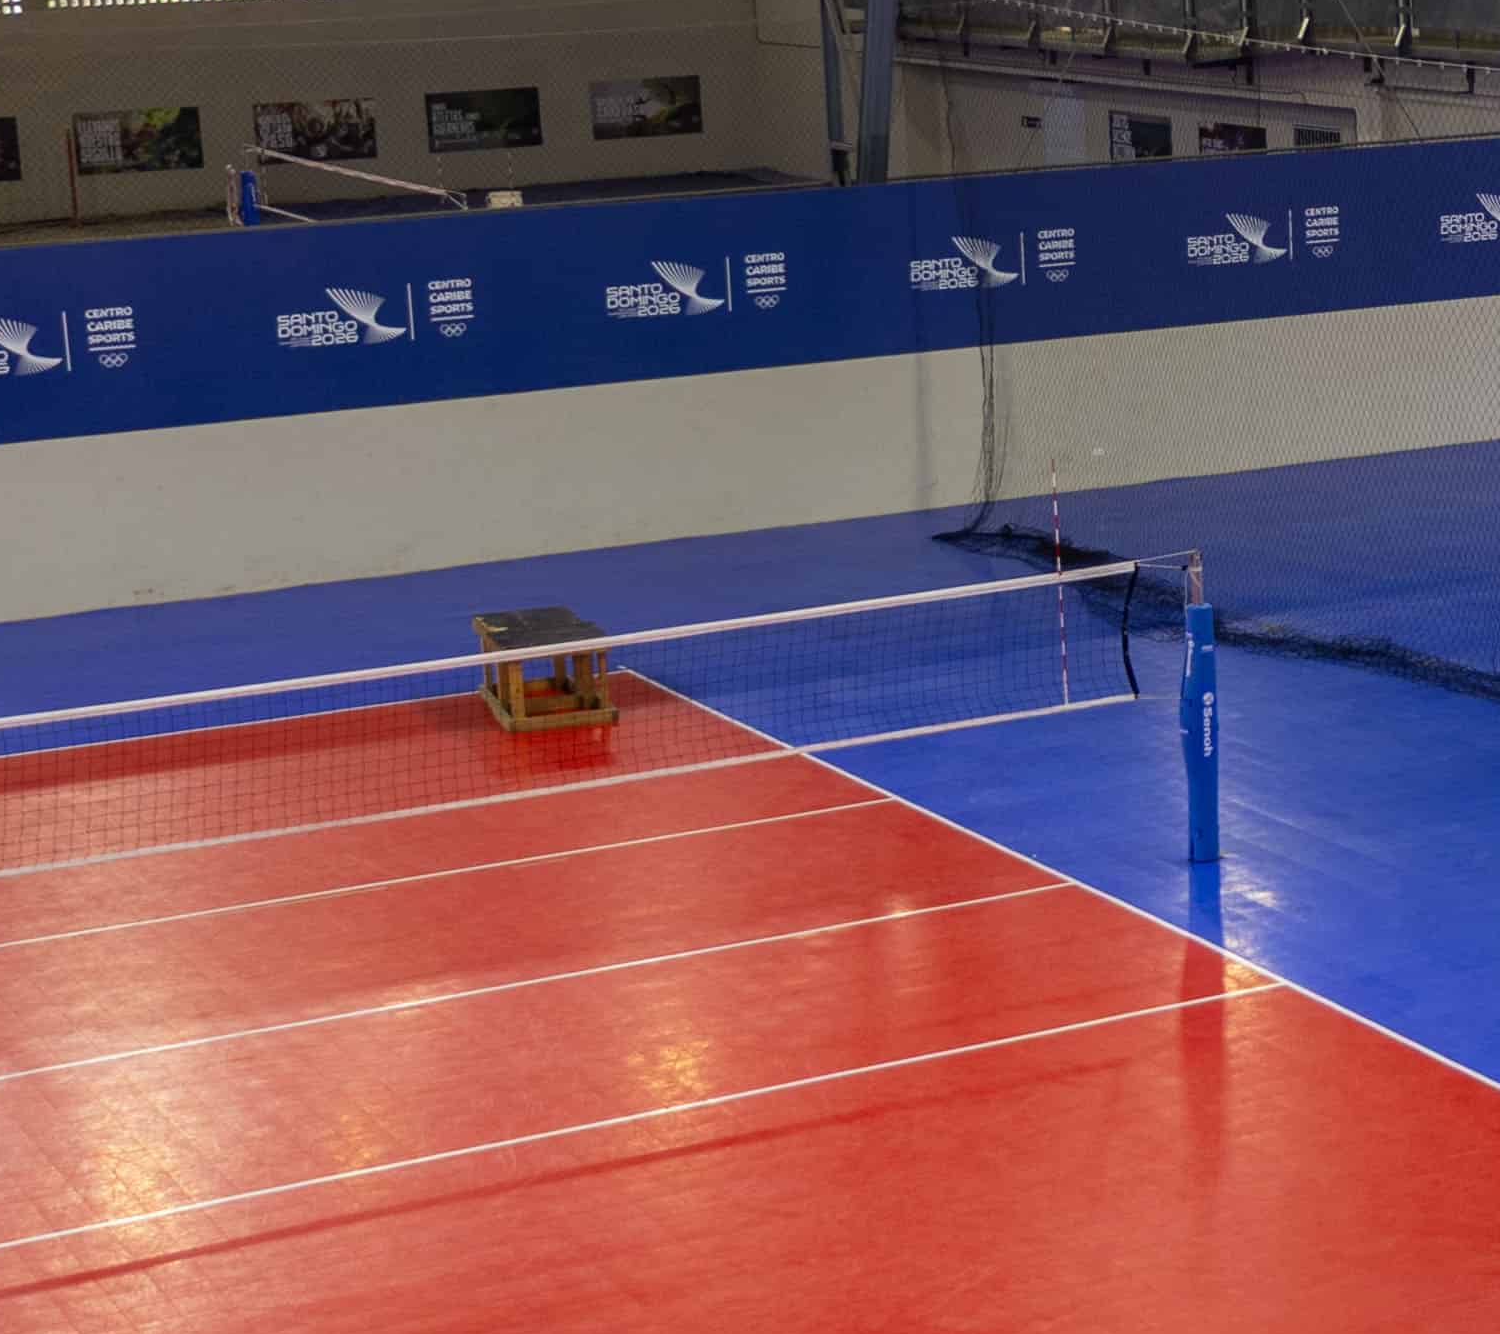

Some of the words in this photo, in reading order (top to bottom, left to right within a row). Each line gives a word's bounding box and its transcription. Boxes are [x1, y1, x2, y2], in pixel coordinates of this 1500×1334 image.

[1305, 206, 1339, 216] CENTRO
[1305, 216, 1340, 227] CARIBE
[1440, 212, 1484, 224] SANTO
[1038, 228, 1075, 239] CENTRO
[1306, 228, 1340, 238] SPORTS
[1441, 221, 1497, 235] DOMINGO
[1187, 233, 1234, 246] SANTO
[1464, 230, 1498, 242] 2026
[1038, 238, 1075, 250] CARIBE
[1188, 242, 1249, 257] DOMINGO
[745, 252, 785, 264] CENTRO
[1039, 251, 1076, 261] SPORTS
[1213, 252, 1249, 264] 2026
[746, 263, 786, 275] CARIBE
[910, 257, 962, 271] SANTO
[911, 266, 977, 282] DOMINGO
[428, 278, 472, 290] CENTRO
[746, 276, 786, 287] SPORTS
[938, 276, 978, 289] 2026
[429, 289, 473, 303] CARIBE
[606, 283, 662, 297] SANTO
[607, 292, 680, 309] DOMINGO
[85, 306, 133, 319] CENTRO
[430, 303, 474, 314] SPORTS
[637, 303, 681, 316] 2026
[87, 318, 134, 332] CARIBE
[277, 311, 338, 326] SANTO
[278, 321, 357, 338] DOMINGO
[88, 332, 135, 344] SPORTS
[311, 331, 358, 346] 2026
[1203, 706, 1214, 757] Senoh
